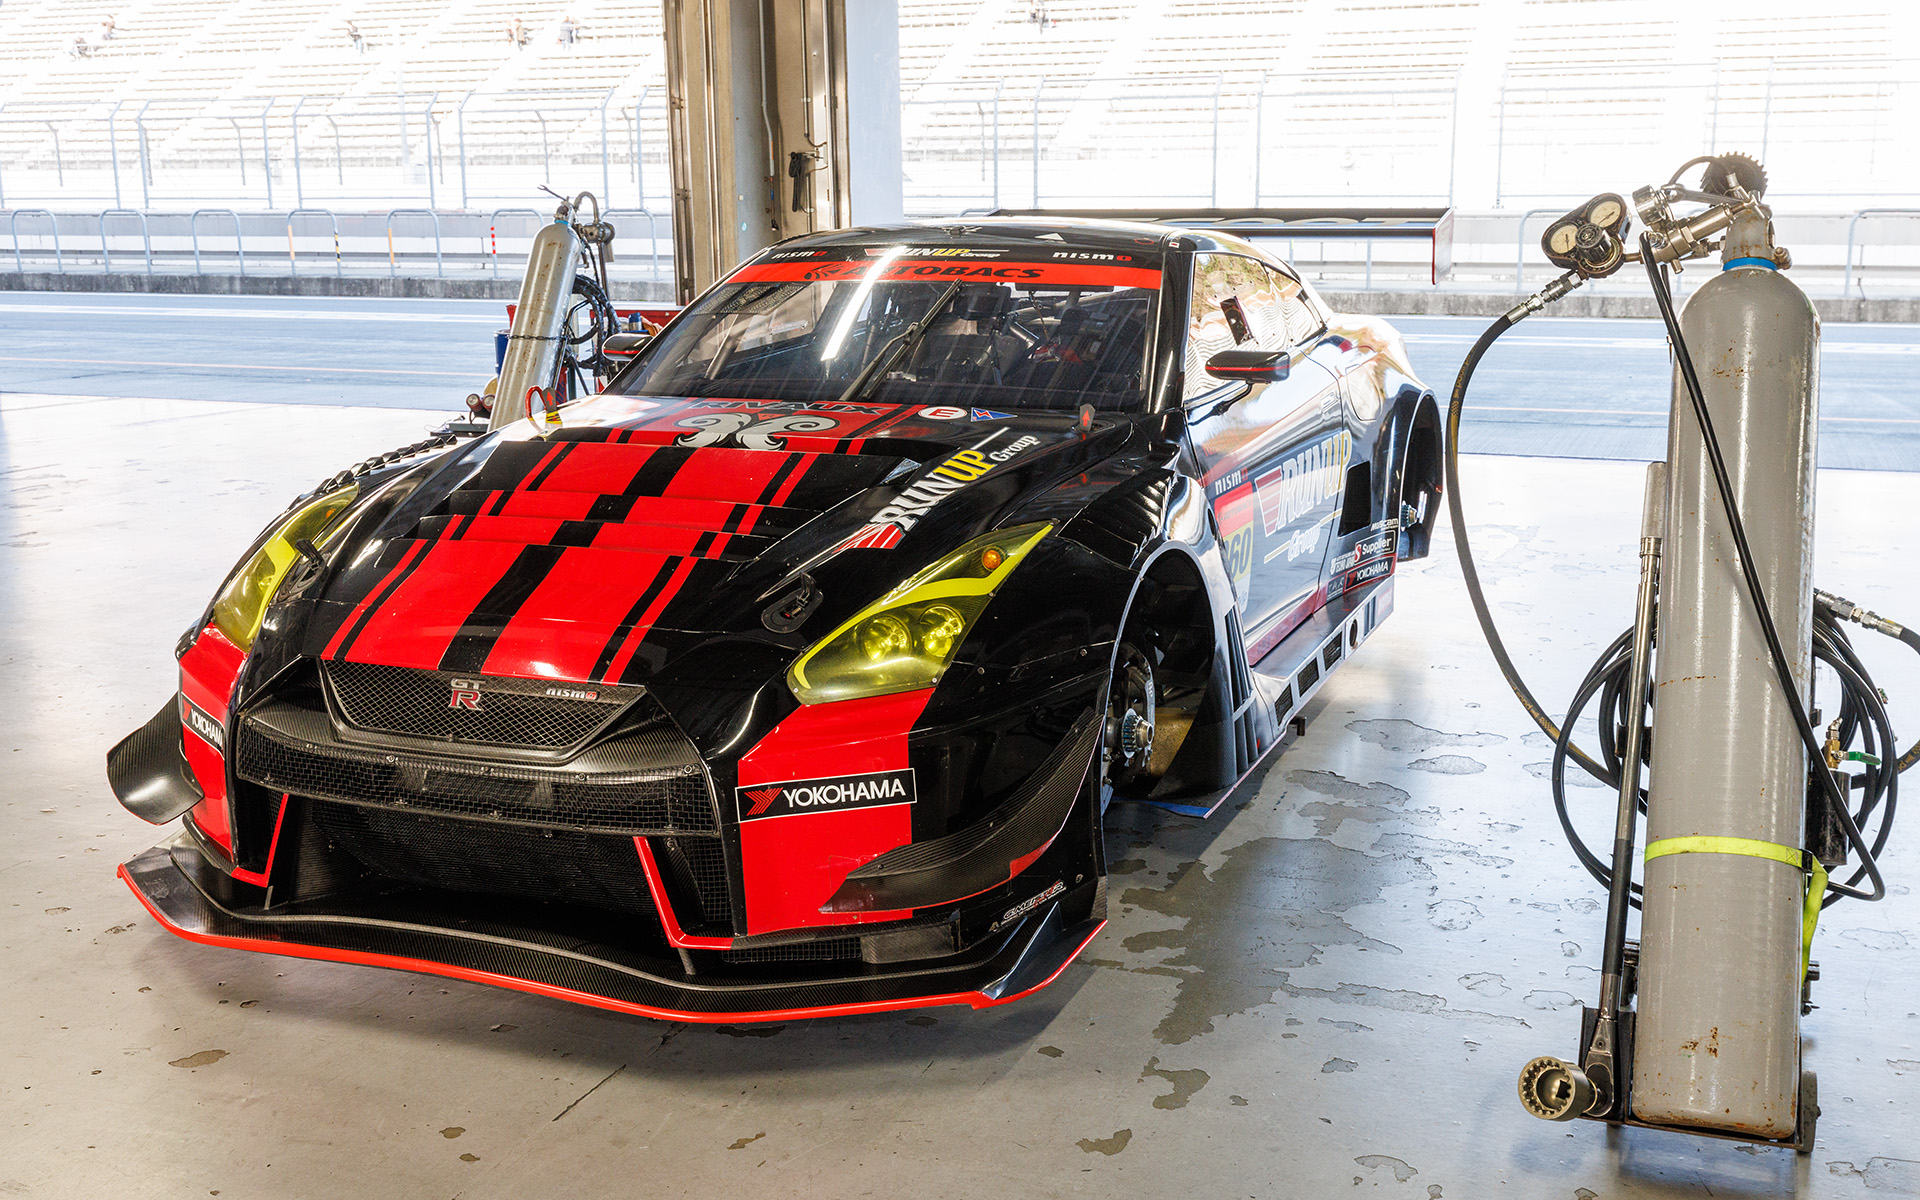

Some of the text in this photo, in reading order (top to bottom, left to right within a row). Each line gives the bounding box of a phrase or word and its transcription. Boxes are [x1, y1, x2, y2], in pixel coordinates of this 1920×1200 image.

[771, 250, 828, 260] nismo
[1053, 251, 1132, 262] nismo
[689, 400, 887, 415] RIVAUX
[989, 434, 1041, 462] Group
[869, 449, 998, 531] RUNUP
[1215, 467, 1249, 495] nismo
[1287, 523, 1321, 562] Group
[1361, 537, 1392, 555] Supplier
[1356, 561, 1389, 582] YOKOHAMA
[450, 678, 487, 691] GT
[546, 687, 598, 700] nismo
[448, 688, 483, 711] R
[782, 778, 906, 808] YOKOHAMA
